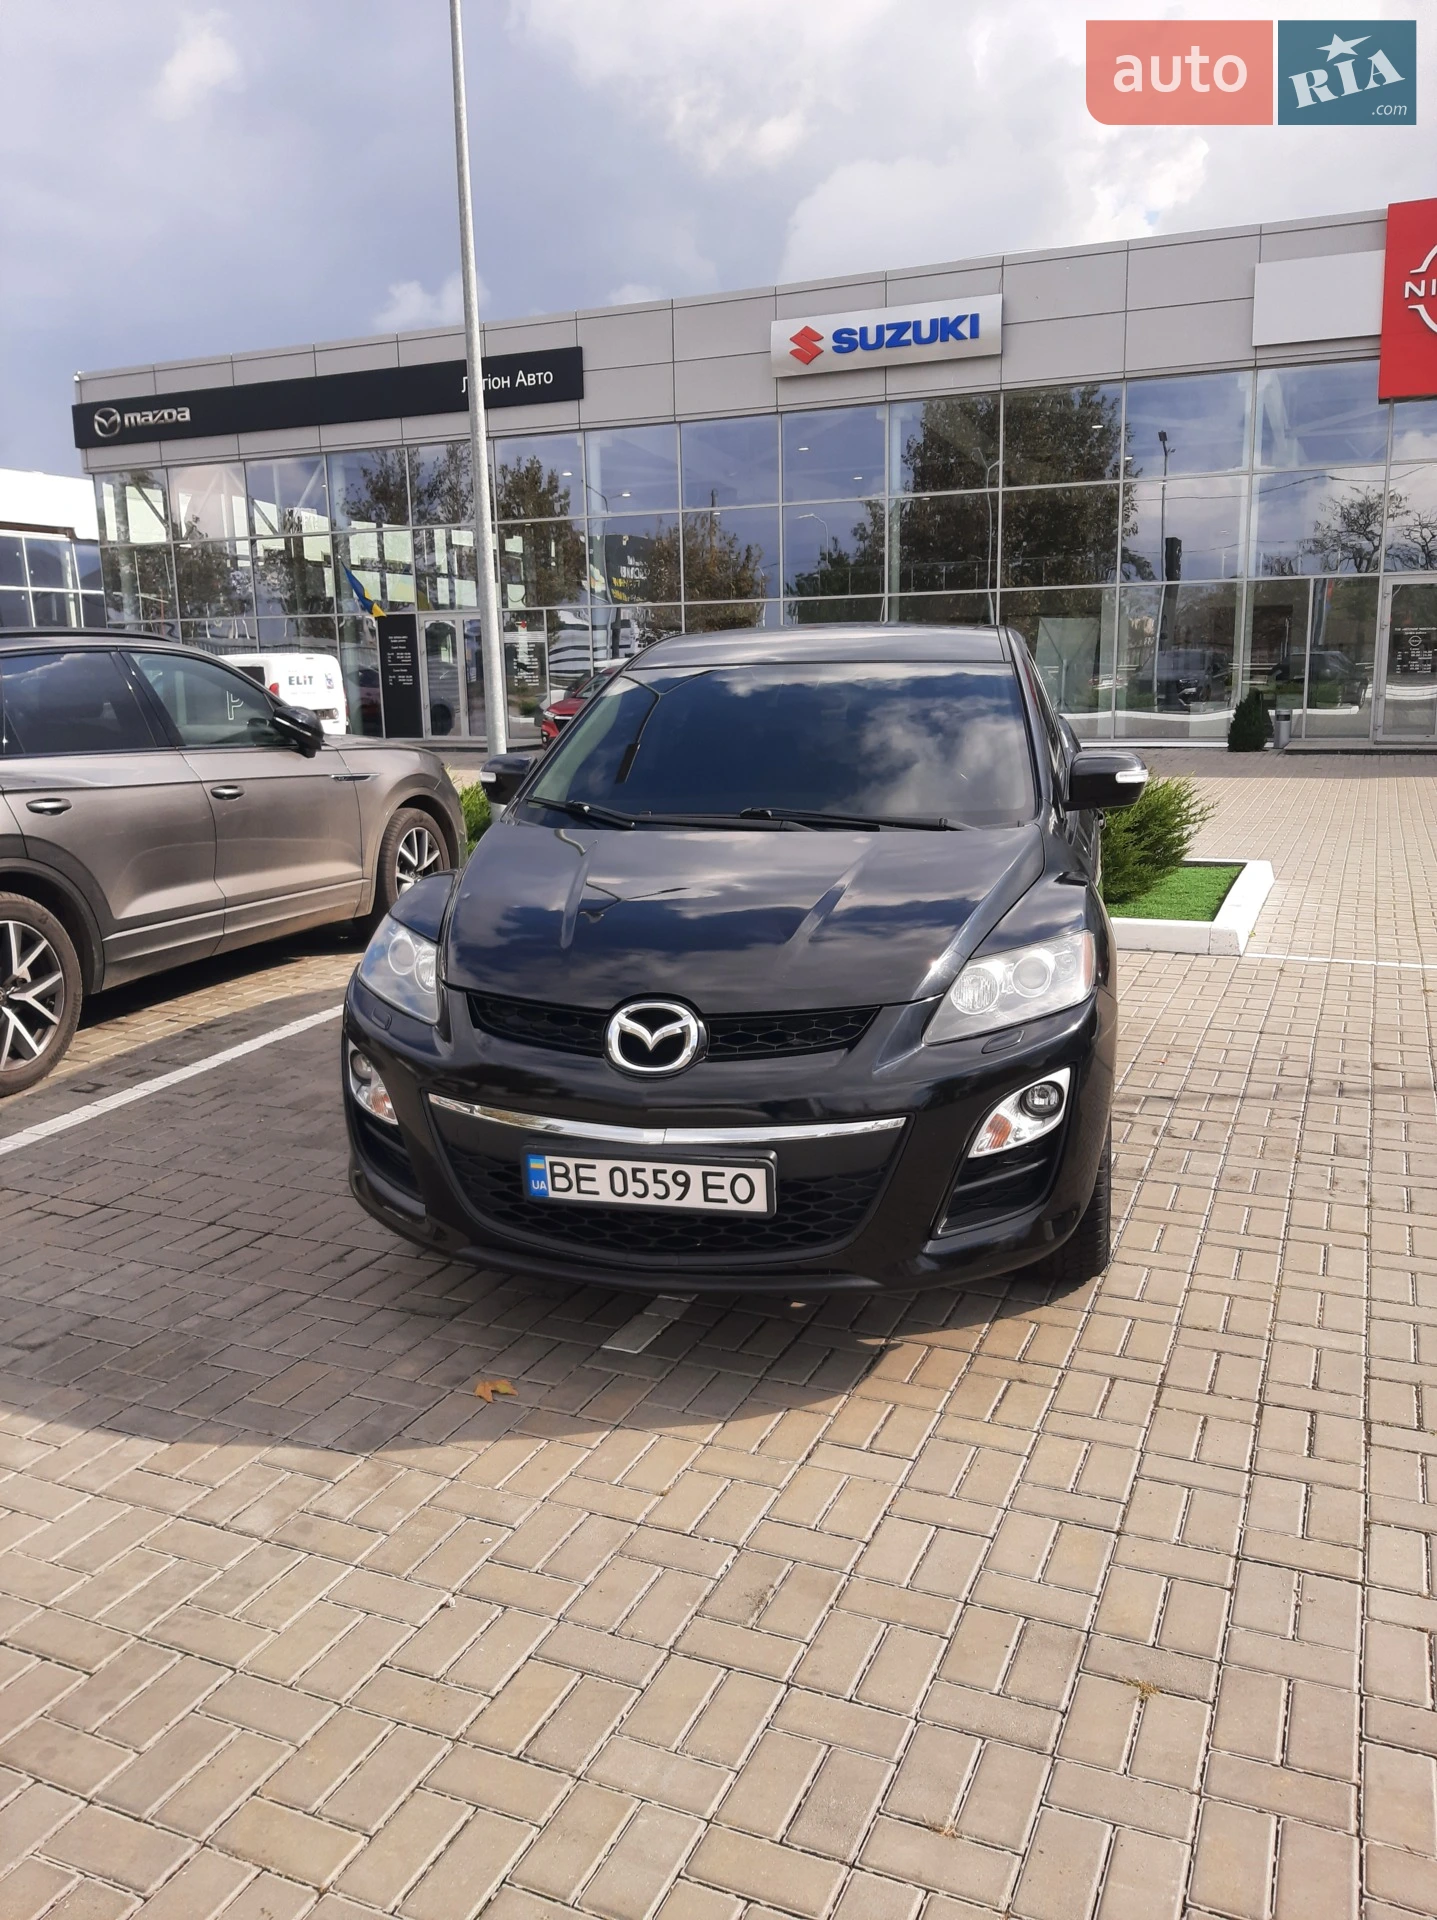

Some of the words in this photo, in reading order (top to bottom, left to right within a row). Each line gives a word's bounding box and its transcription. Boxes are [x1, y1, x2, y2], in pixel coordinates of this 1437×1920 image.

[831, 313, 980, 354] SUZUKI
[461, 373, 511, 393] Лгіон
[515, 369, 554, 388] Авто
[123, 406, 191, 428] mazda
[531, 1179, 547, 1190] UA
[549, 1160, 600, 1196] BE
[608, 1165, 692, 1201] 0559
[701, 1170, 756, 1205] EO
